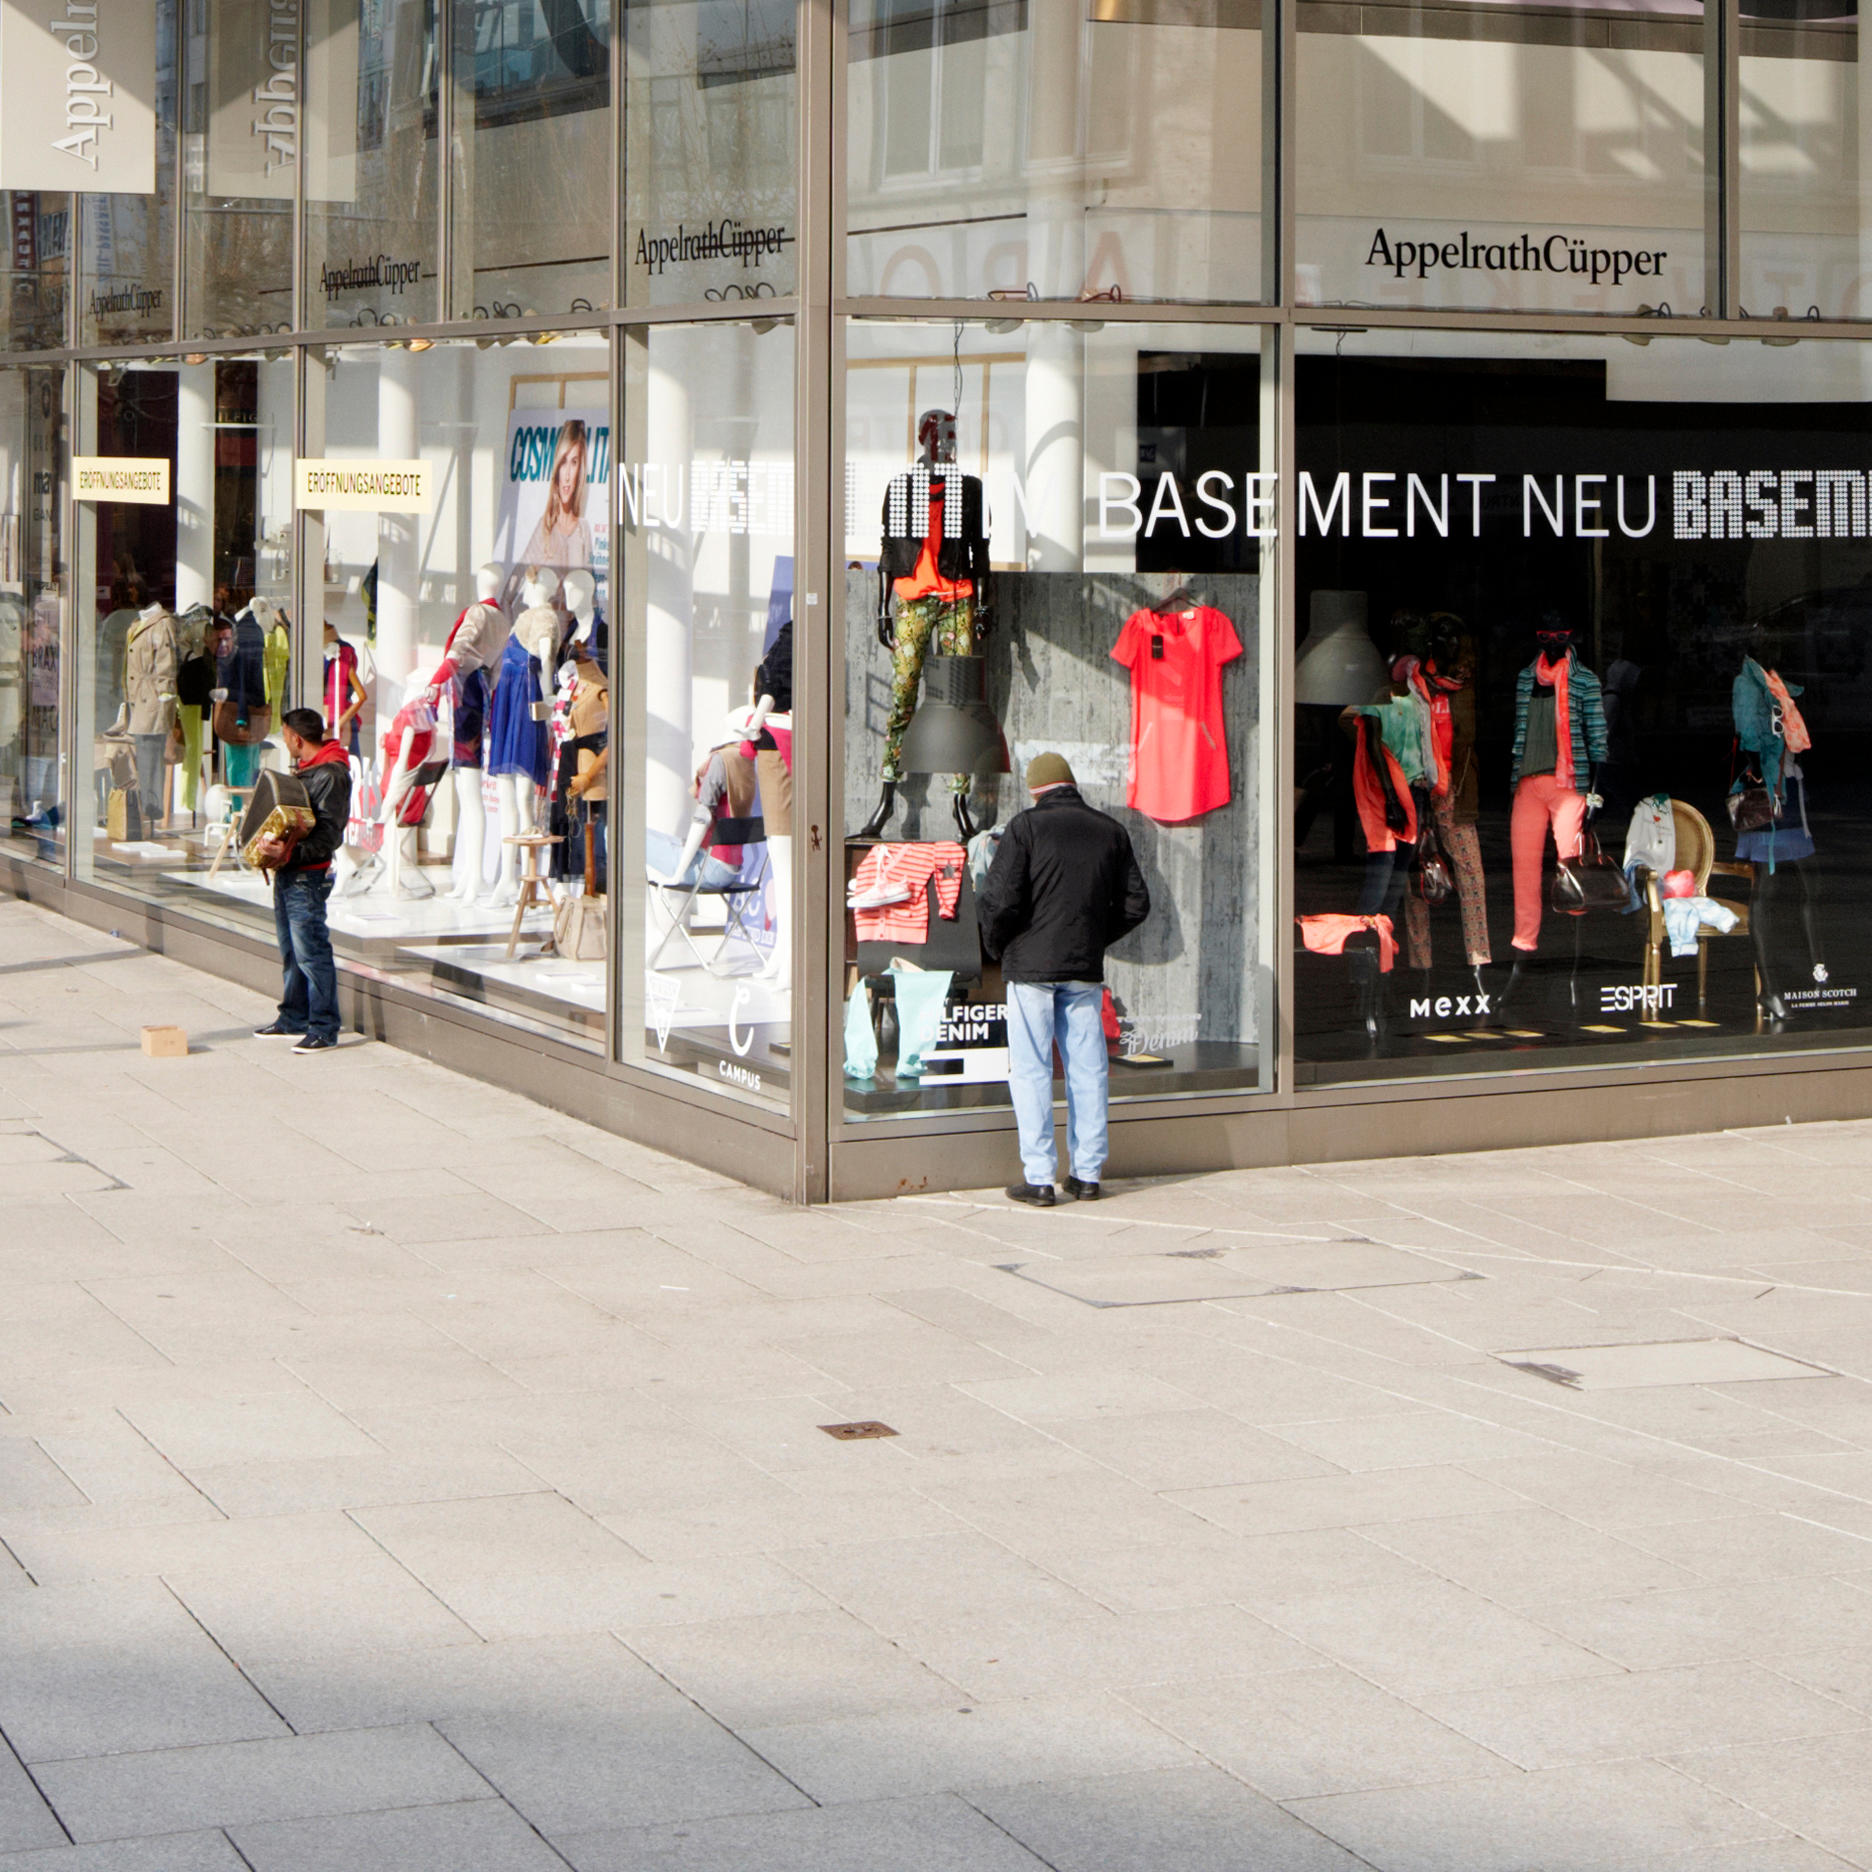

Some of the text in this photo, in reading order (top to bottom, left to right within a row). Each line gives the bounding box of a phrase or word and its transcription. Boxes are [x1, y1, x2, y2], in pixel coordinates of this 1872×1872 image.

[634, 218, 786, 277] AppelrathCüpper
[1365, 228, 1668, 287] AppelrathCüpper
[318, 253, 422, 302] AppelrathCüpper
[306, 467, 423, 498] ERÖFFNUNGSANGEBOTE
[617, 461, 685, 530] NEU
[1098, 471, 1496, 539] BASEMENT
[1523, 474, 1656, 539] NEU
[1600, 983, 1678, 1013] ESPRIT
[1783, 987, 1858, 1001] MAISON SCOTCH
[718, 1059, 762, 1091] CAMPUS
